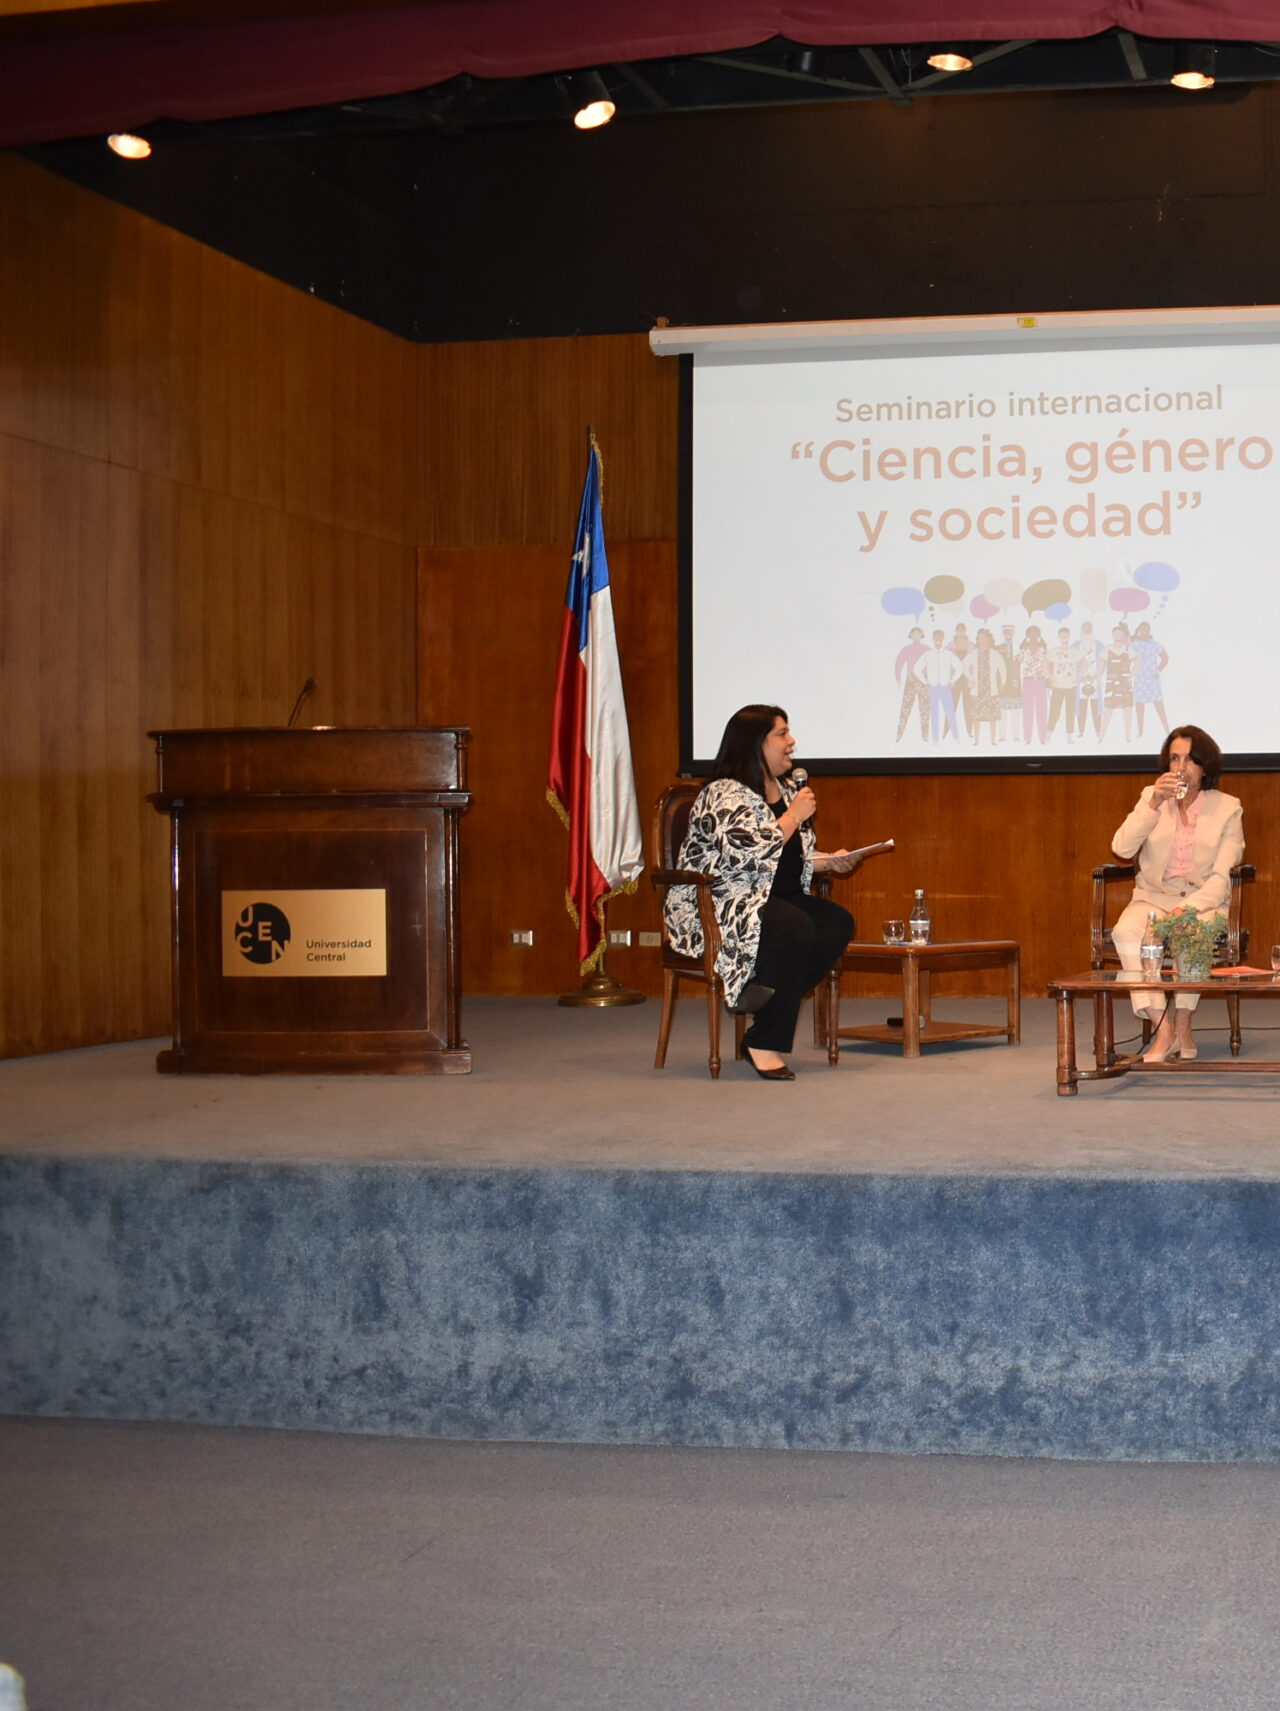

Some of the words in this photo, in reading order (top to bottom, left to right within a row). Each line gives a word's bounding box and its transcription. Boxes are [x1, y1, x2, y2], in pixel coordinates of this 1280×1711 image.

[834, 392, 997, 424] Seminario
[1007, 383, 1224, 417] internacional
[790, 433, 1044, 485] “Ciencia,
[1065, 427, 1274, 485] género
[857, 507, 888, 553] y
[907, 491, 1203, 543] sociedad”
[306, 938, 372, 950] Universidad
[306, 951, 346, 963] Central
